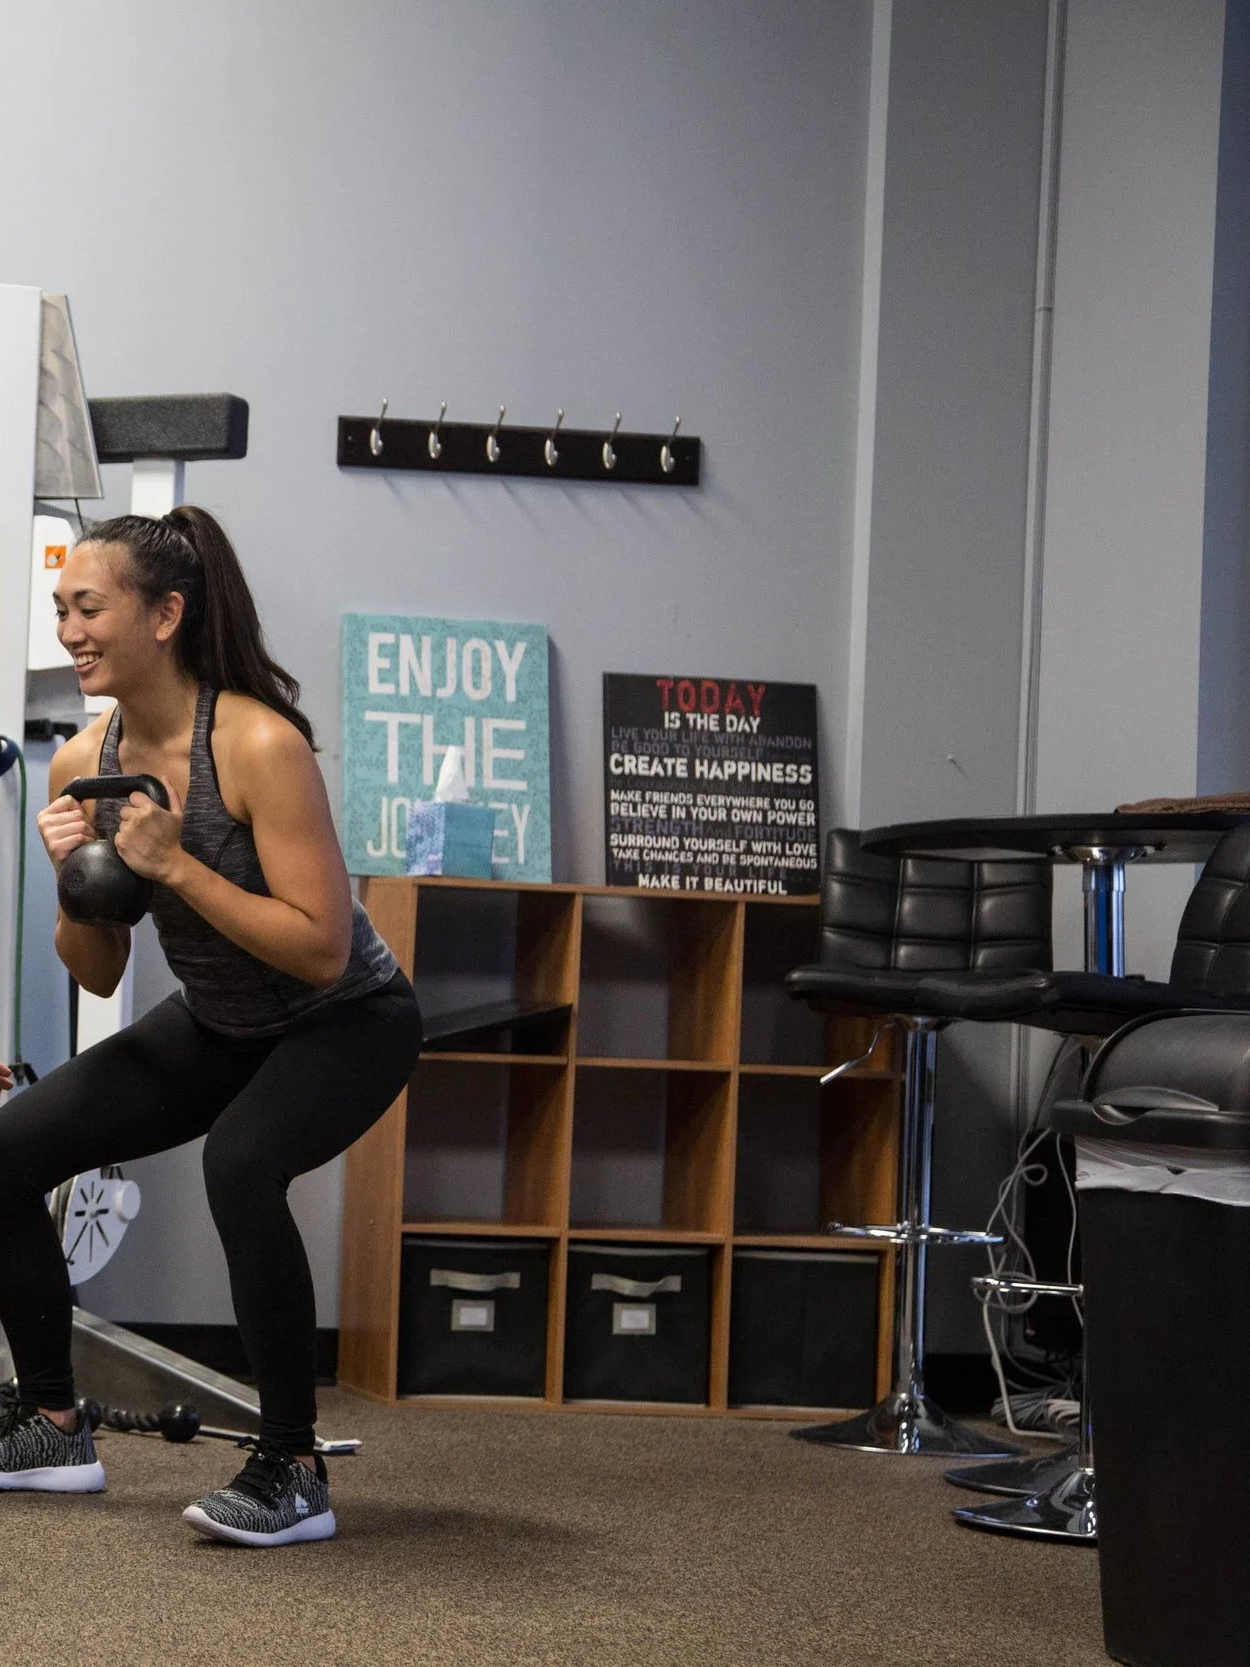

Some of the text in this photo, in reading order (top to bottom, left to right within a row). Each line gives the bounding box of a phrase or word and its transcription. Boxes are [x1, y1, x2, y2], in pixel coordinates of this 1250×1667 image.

[368, 632, 526, 703] ENJOY
[656, 678, 766, 716] TODAY
[664, 711, 761, 734] IS THE DAY
[611, 726, 812, 749] LIVE YOUR LIFE WITH ABANDON
[364, 711, 527, 790] THE
[611, 739, 631, 753] BE
[633, 740, 670, 755] GOOD
[675, 742, 690, 757] TO
[695, 744, 763, 761] YOURSELF
[609, 753, 813, 785] CREATE HAPPINESS
[610, 789, 814, 811] MAKE FRIENDS EVERYWHERE YOU GO
[610, 803, 816, 826] BELIEVE IN YOUR OWN POWER
[366, 797, 531, 865] JOEY
[610, 817, 704, 836] STRENGTH
[735, 825, 817, 842] FORTITUDE
[610, 833, 817, 857] SURROUND YOURSELF WITH LOVE
[612, 848, 817, 869] TAKE CHANCES AND BE SPONTANEOUS
[613, 860, 653, 874] THIS
[664, 862, 682, 875] IS
[693, 863, 737, 878] YOUR
[638, 873, 788, 895] MAKE IT BEAUTIFUL
